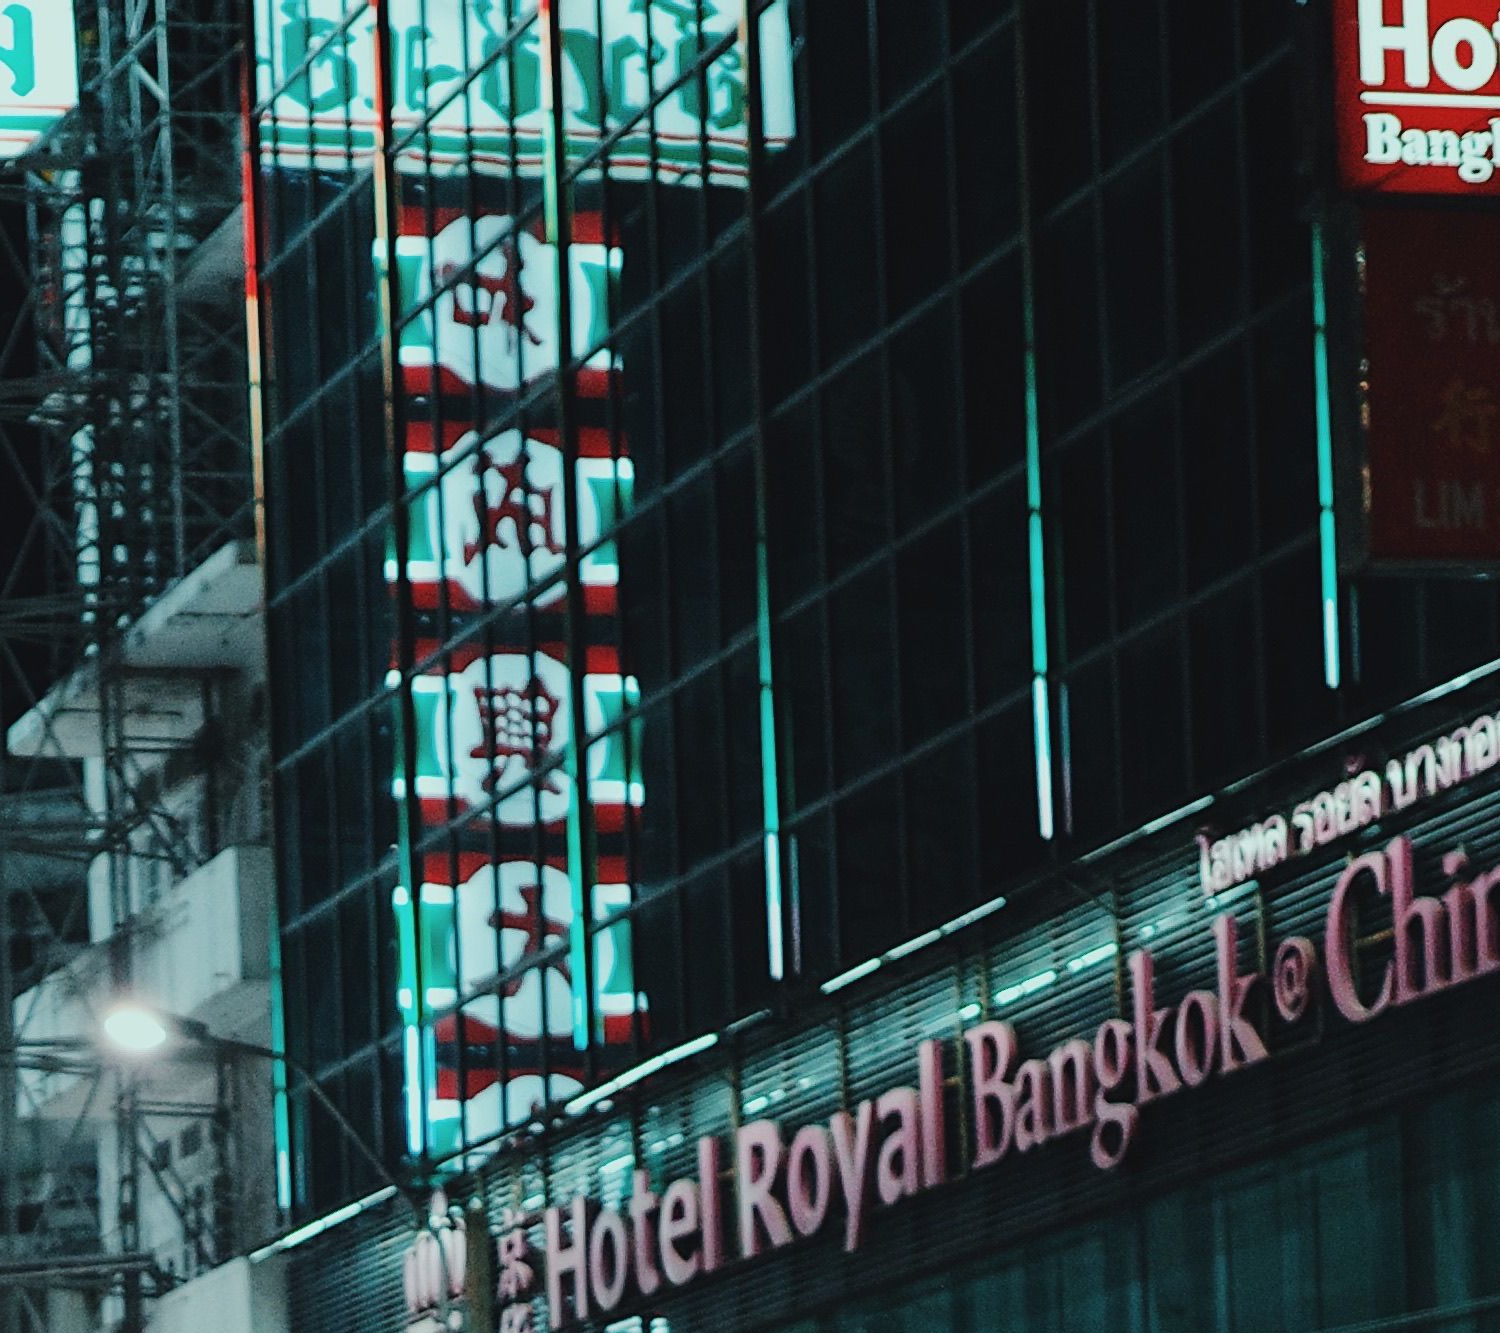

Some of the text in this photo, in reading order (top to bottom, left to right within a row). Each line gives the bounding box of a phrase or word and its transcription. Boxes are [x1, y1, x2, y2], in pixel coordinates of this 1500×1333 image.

[1413, 480, 1488, 530] LIM
[543, 1135, 720, 1328] Hotel
[737, 1038, 944, 1258] Royal
[966, 913, 1270, 1168] Bangkok
[1272, 935, 1317, 1022] @
